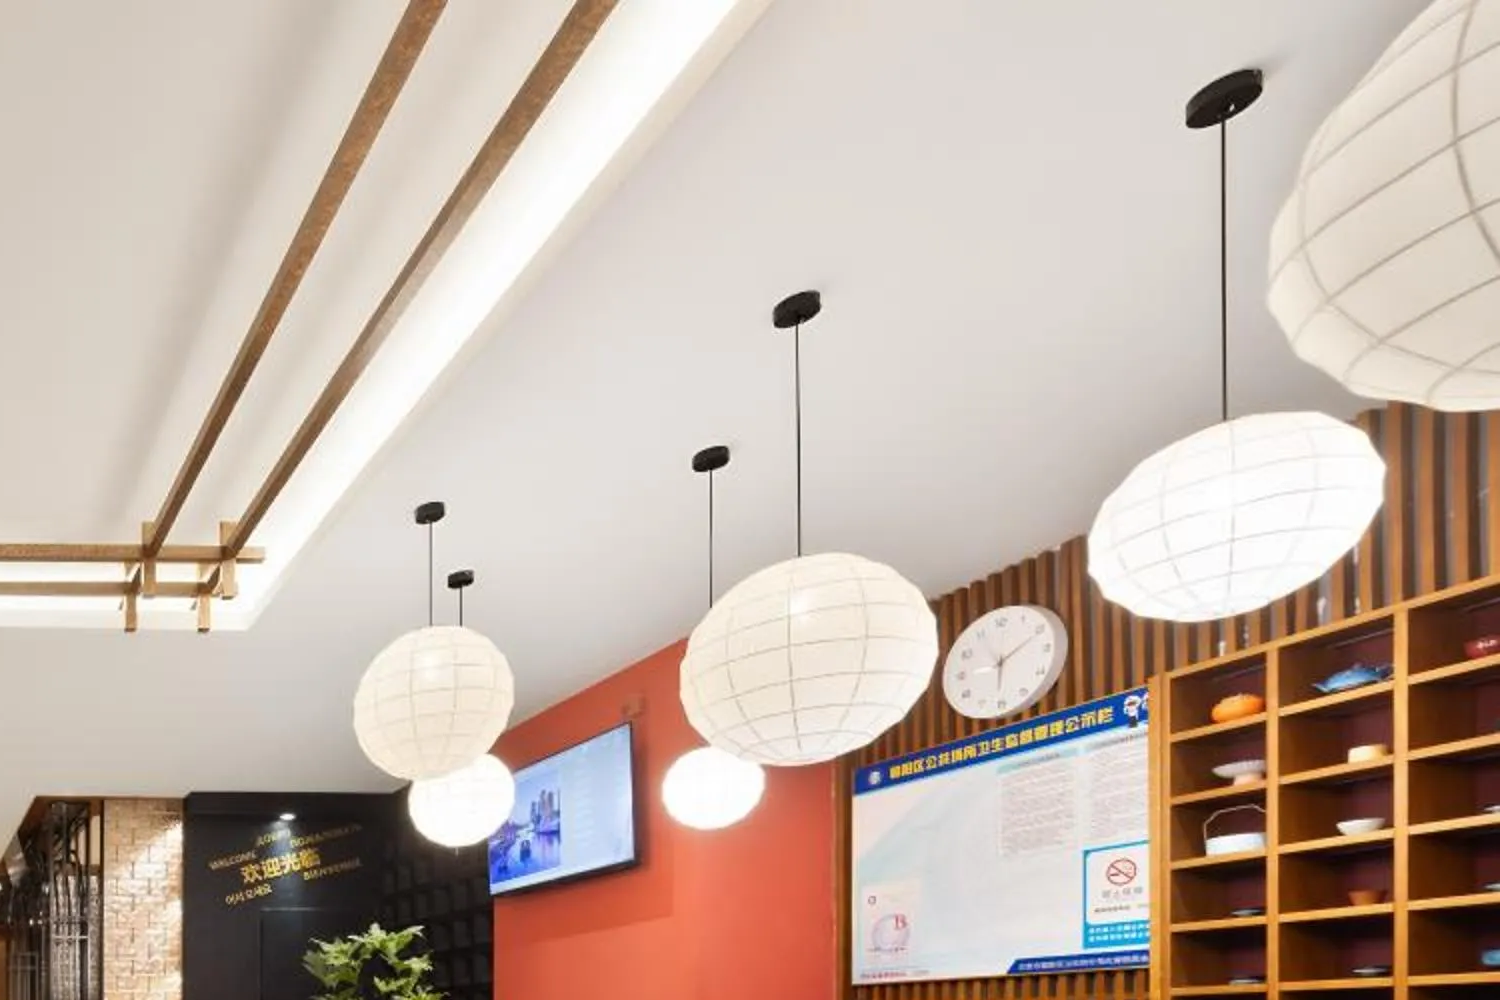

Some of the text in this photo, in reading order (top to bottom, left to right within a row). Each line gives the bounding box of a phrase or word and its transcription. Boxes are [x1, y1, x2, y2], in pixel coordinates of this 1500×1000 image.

[208, 849, 257, 870] WELCOME
[240, 848, 321, 884] 欢迎光临
